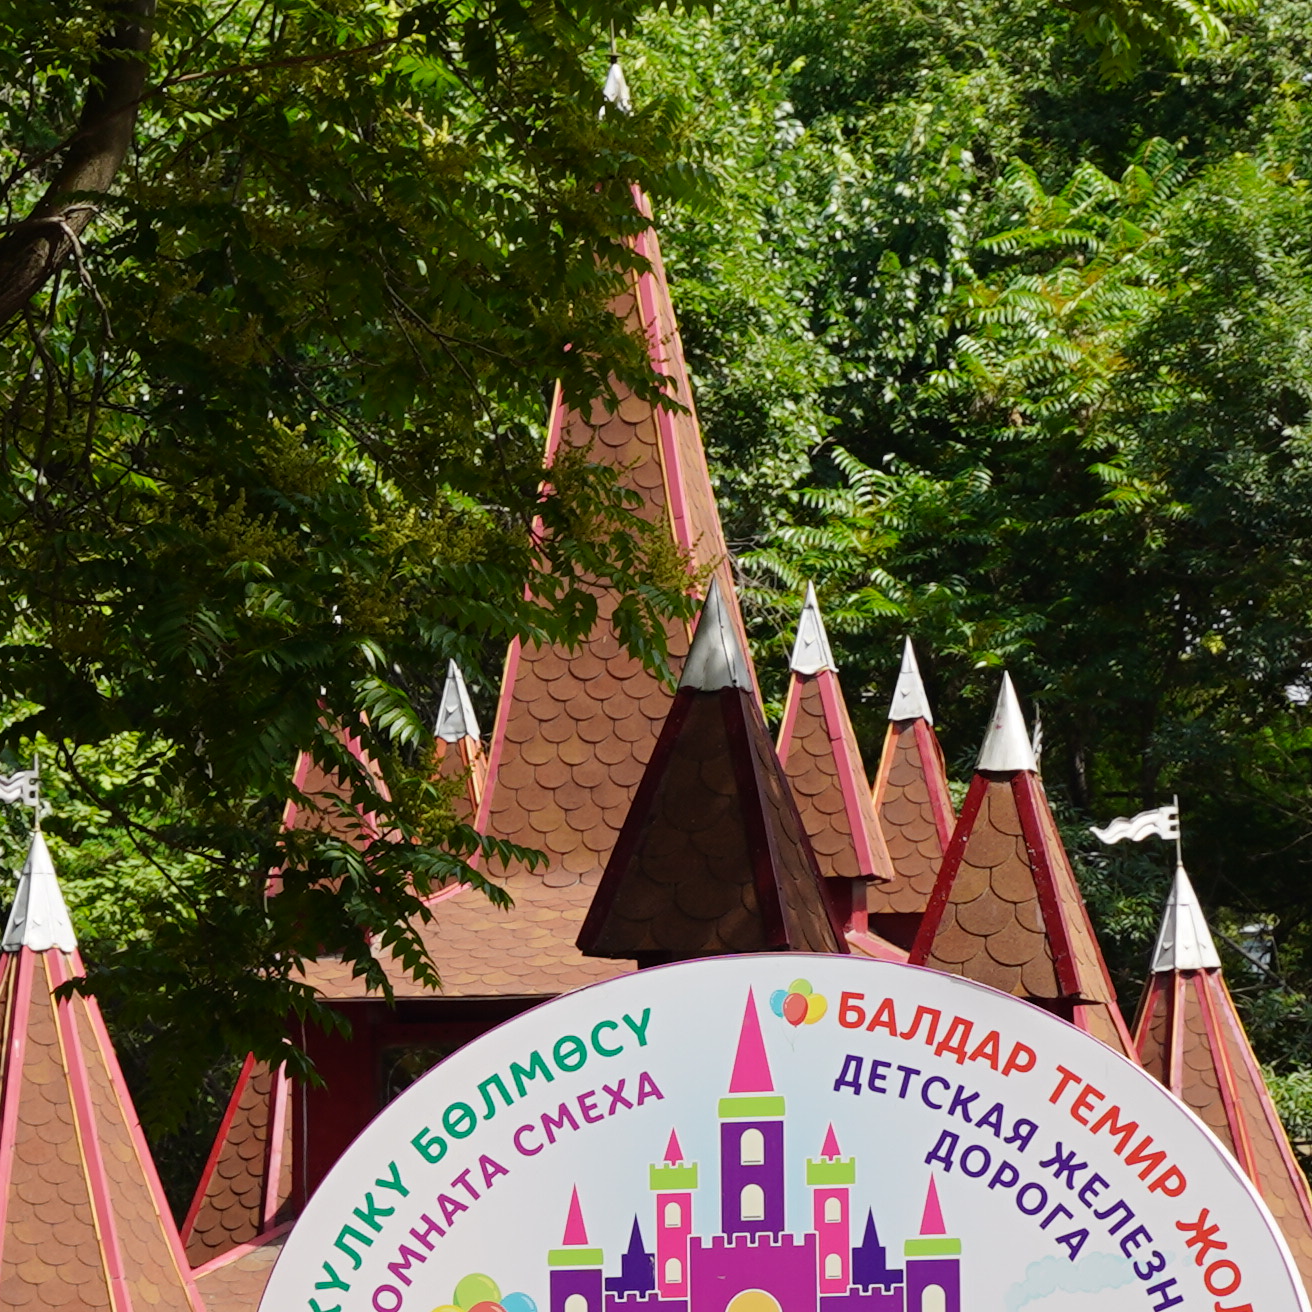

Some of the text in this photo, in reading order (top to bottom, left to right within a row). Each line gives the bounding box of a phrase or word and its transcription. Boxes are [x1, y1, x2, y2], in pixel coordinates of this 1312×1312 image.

[512, 1071, 665, 1157] СМЕХА
[832, 1054, 1040, 1153] ДЕТСКАЯ
[837, 991, 1038, 1077] БАЛДАР
[1048, 1064, 1188, 1198] ТЕМИР
[924, 1129, 1090, 1262] ДОРОГА
